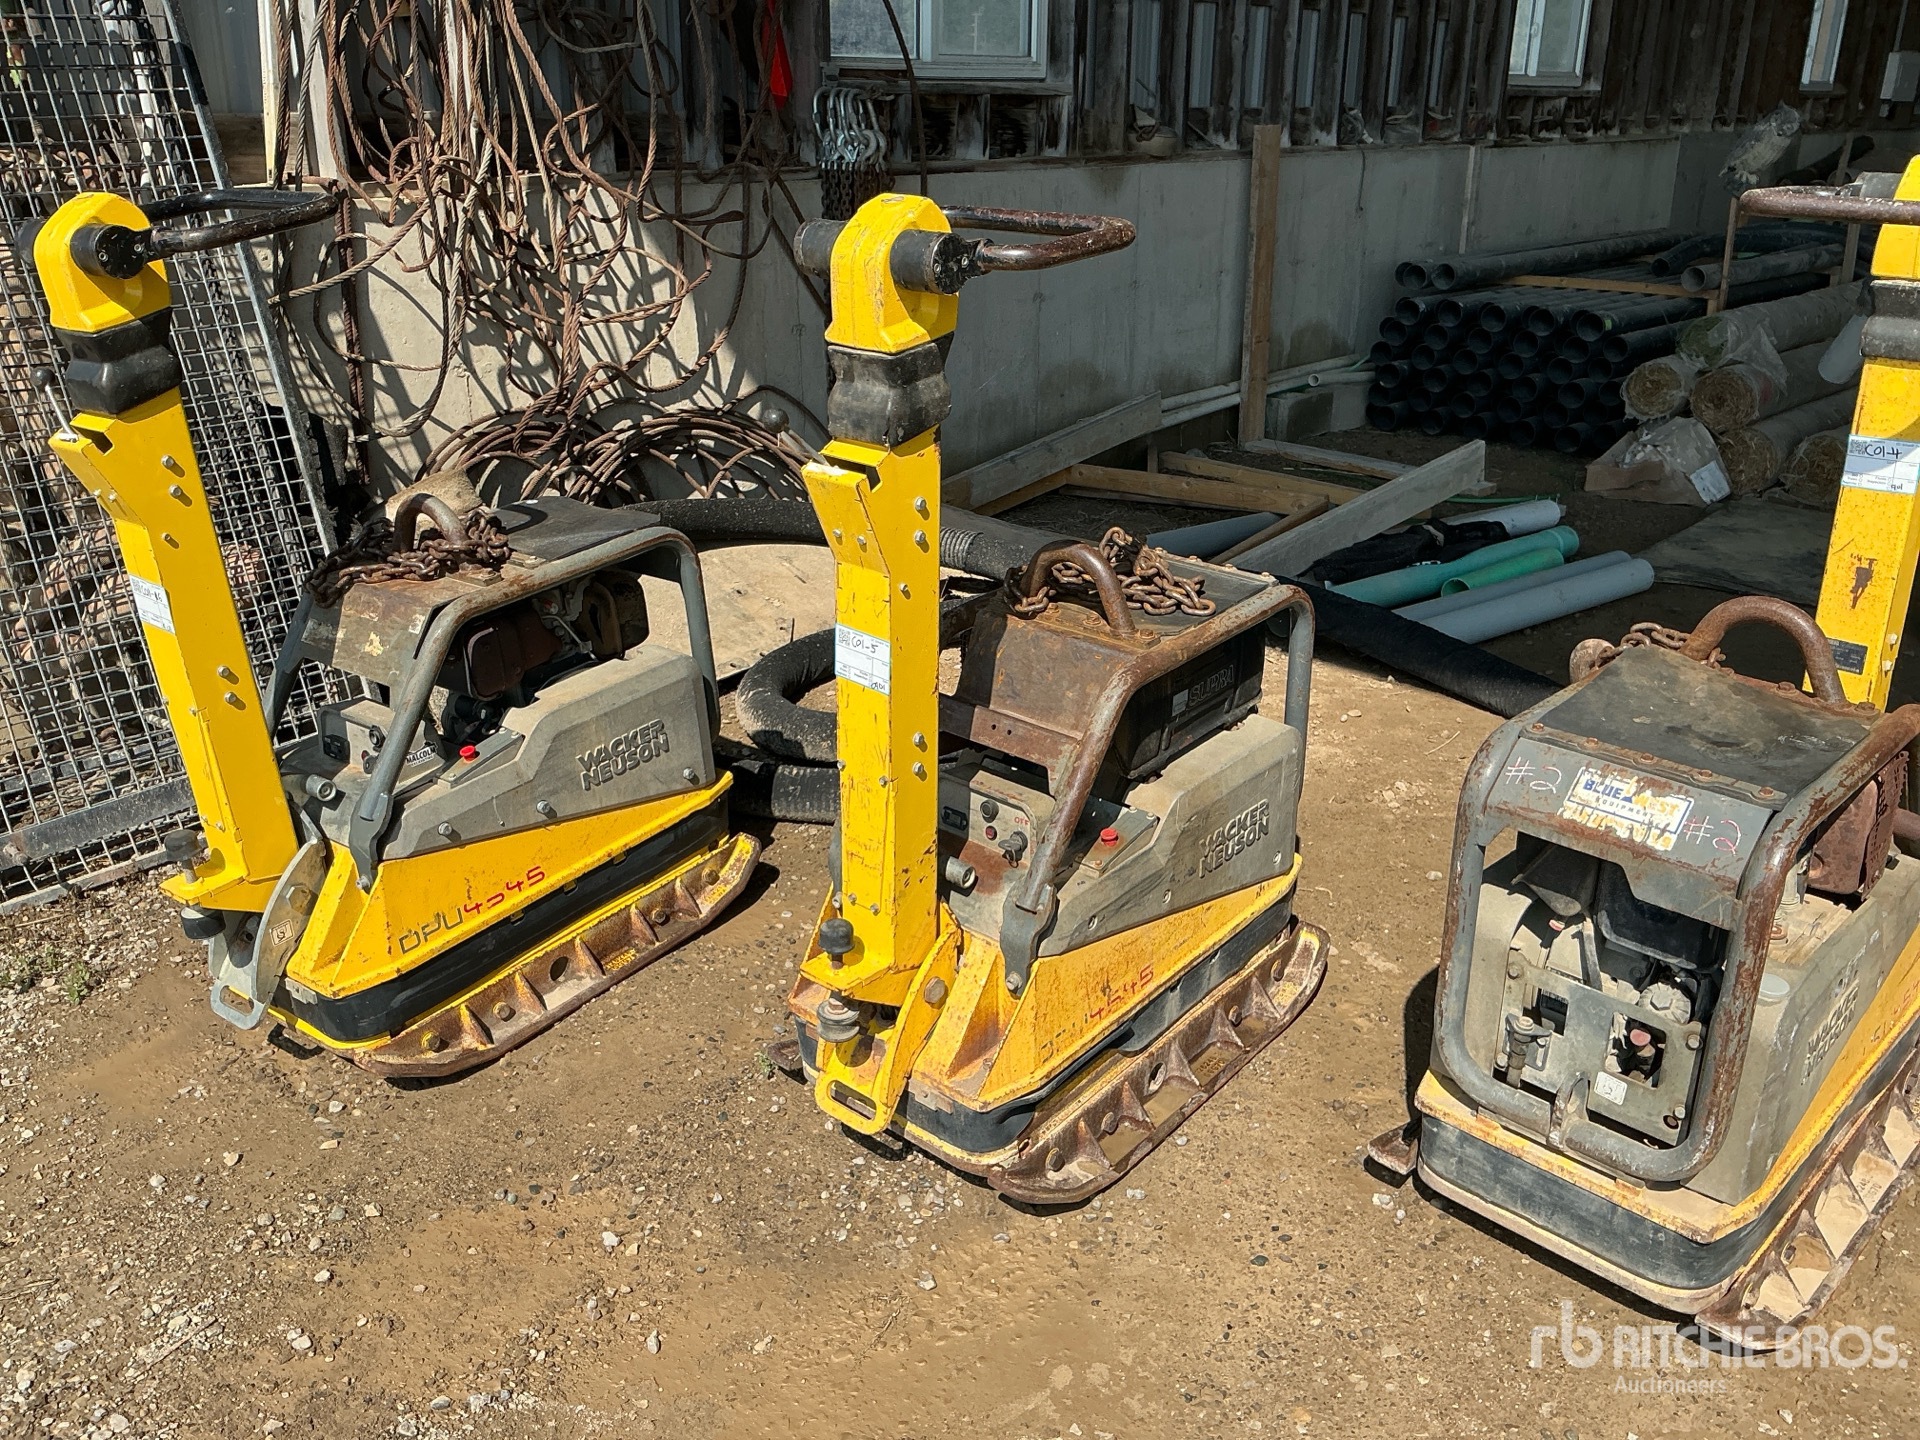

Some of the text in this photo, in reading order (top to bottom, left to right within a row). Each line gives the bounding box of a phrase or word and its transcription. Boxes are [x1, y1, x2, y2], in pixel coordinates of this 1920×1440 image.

[851, 635, 879, 654] C01-5
[1188, 664, 1234, 707] SUPRA
[406, 746, 437, 764] MALCOLM
[575, 718, 665, 773] WACKER
[581, 731, 670, 791] NEUSON
[1506, 755, 1563, 795] #2
[1582, 778, 1624, 800] BLUE
[1198, 816, 1270, 879] NEUSON
[1199, 798, 1270, 858] WACKER
[1684, 815, 1742, 856] #2
